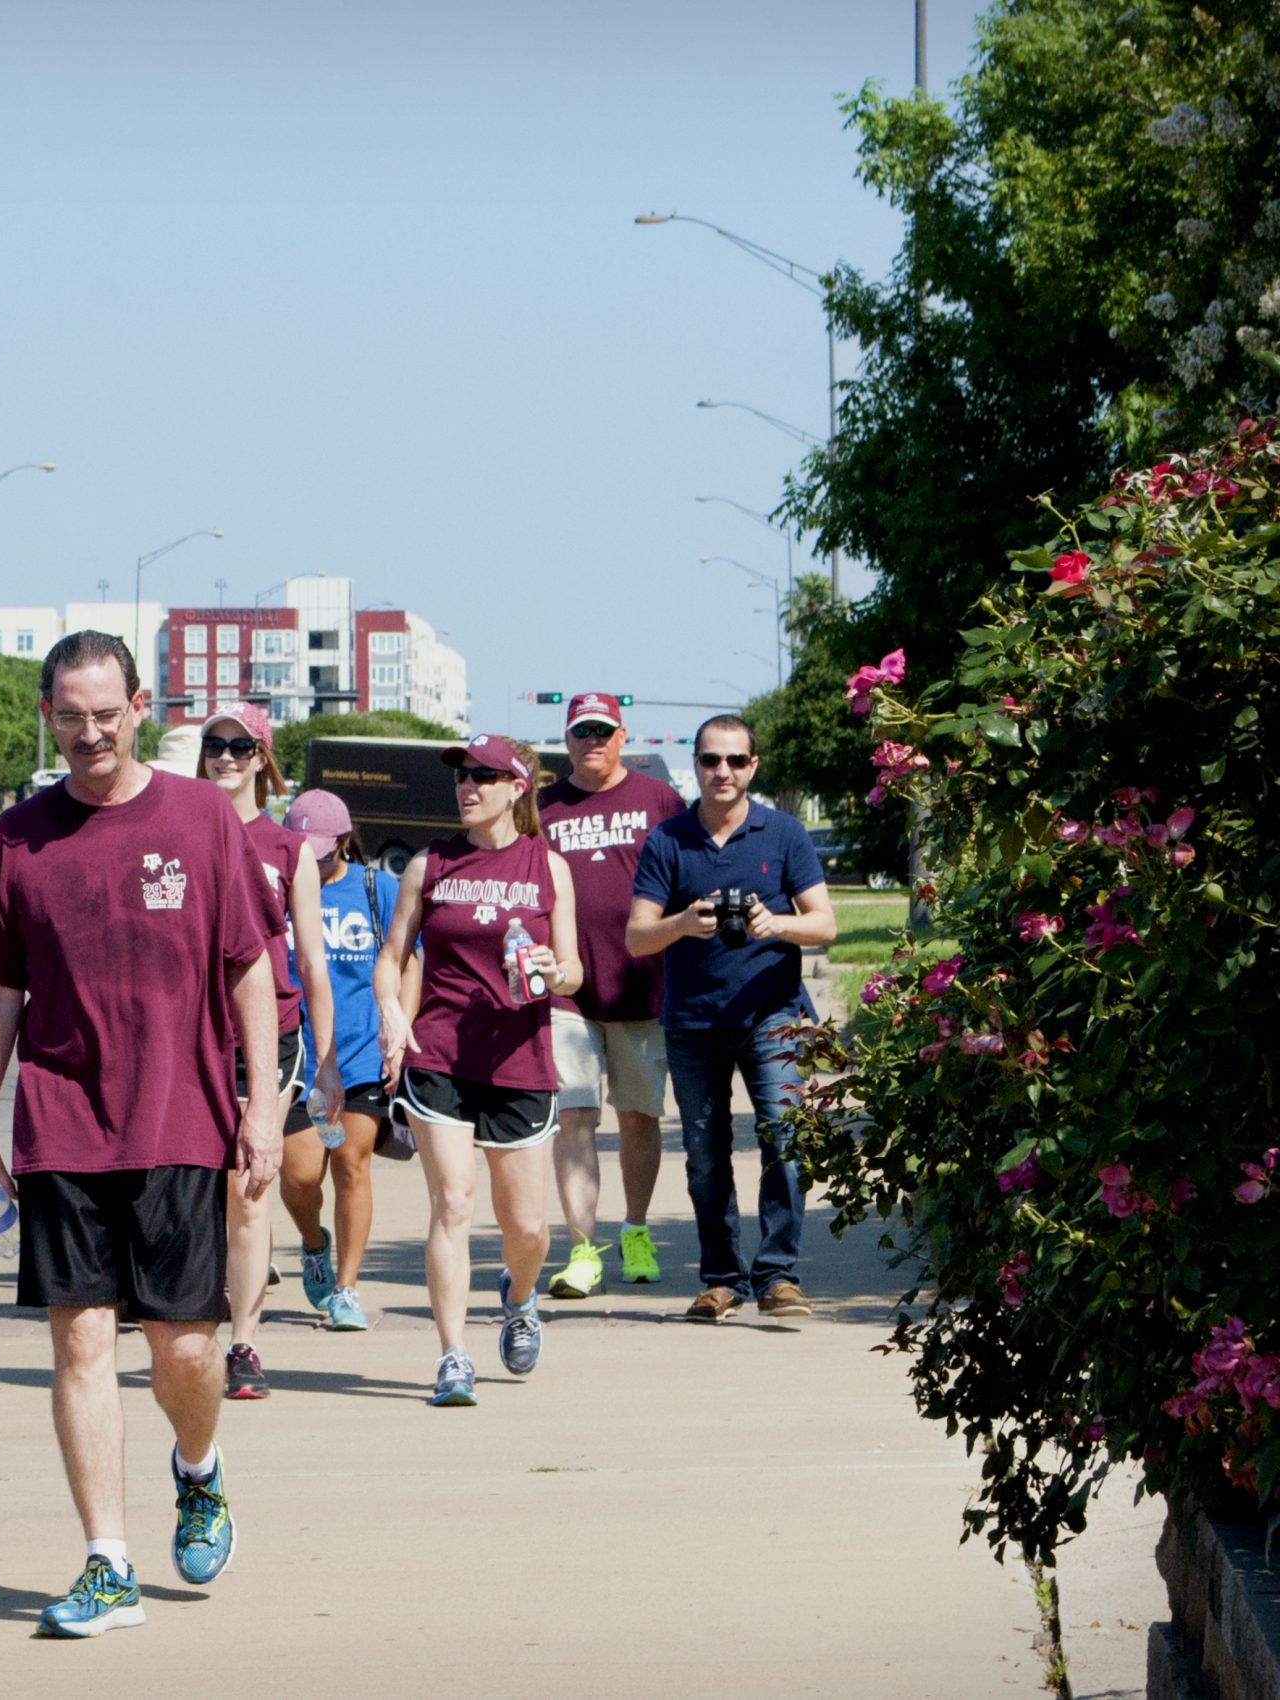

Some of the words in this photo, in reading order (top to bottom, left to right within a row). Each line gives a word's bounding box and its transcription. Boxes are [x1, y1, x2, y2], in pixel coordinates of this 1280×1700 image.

[322, 768, 360, 779] Worldwide
[361, 770, 392, 782] Services
[547, 814, 605, 840] TEXAS
[610, 810, 648, 830] A&M
[560, 828, 636, 853] BASEBALL
[431, 879, 507, 904] MAROON
[508, 881, 540, 907] OUT
[320, 907, 339, 917] THE
